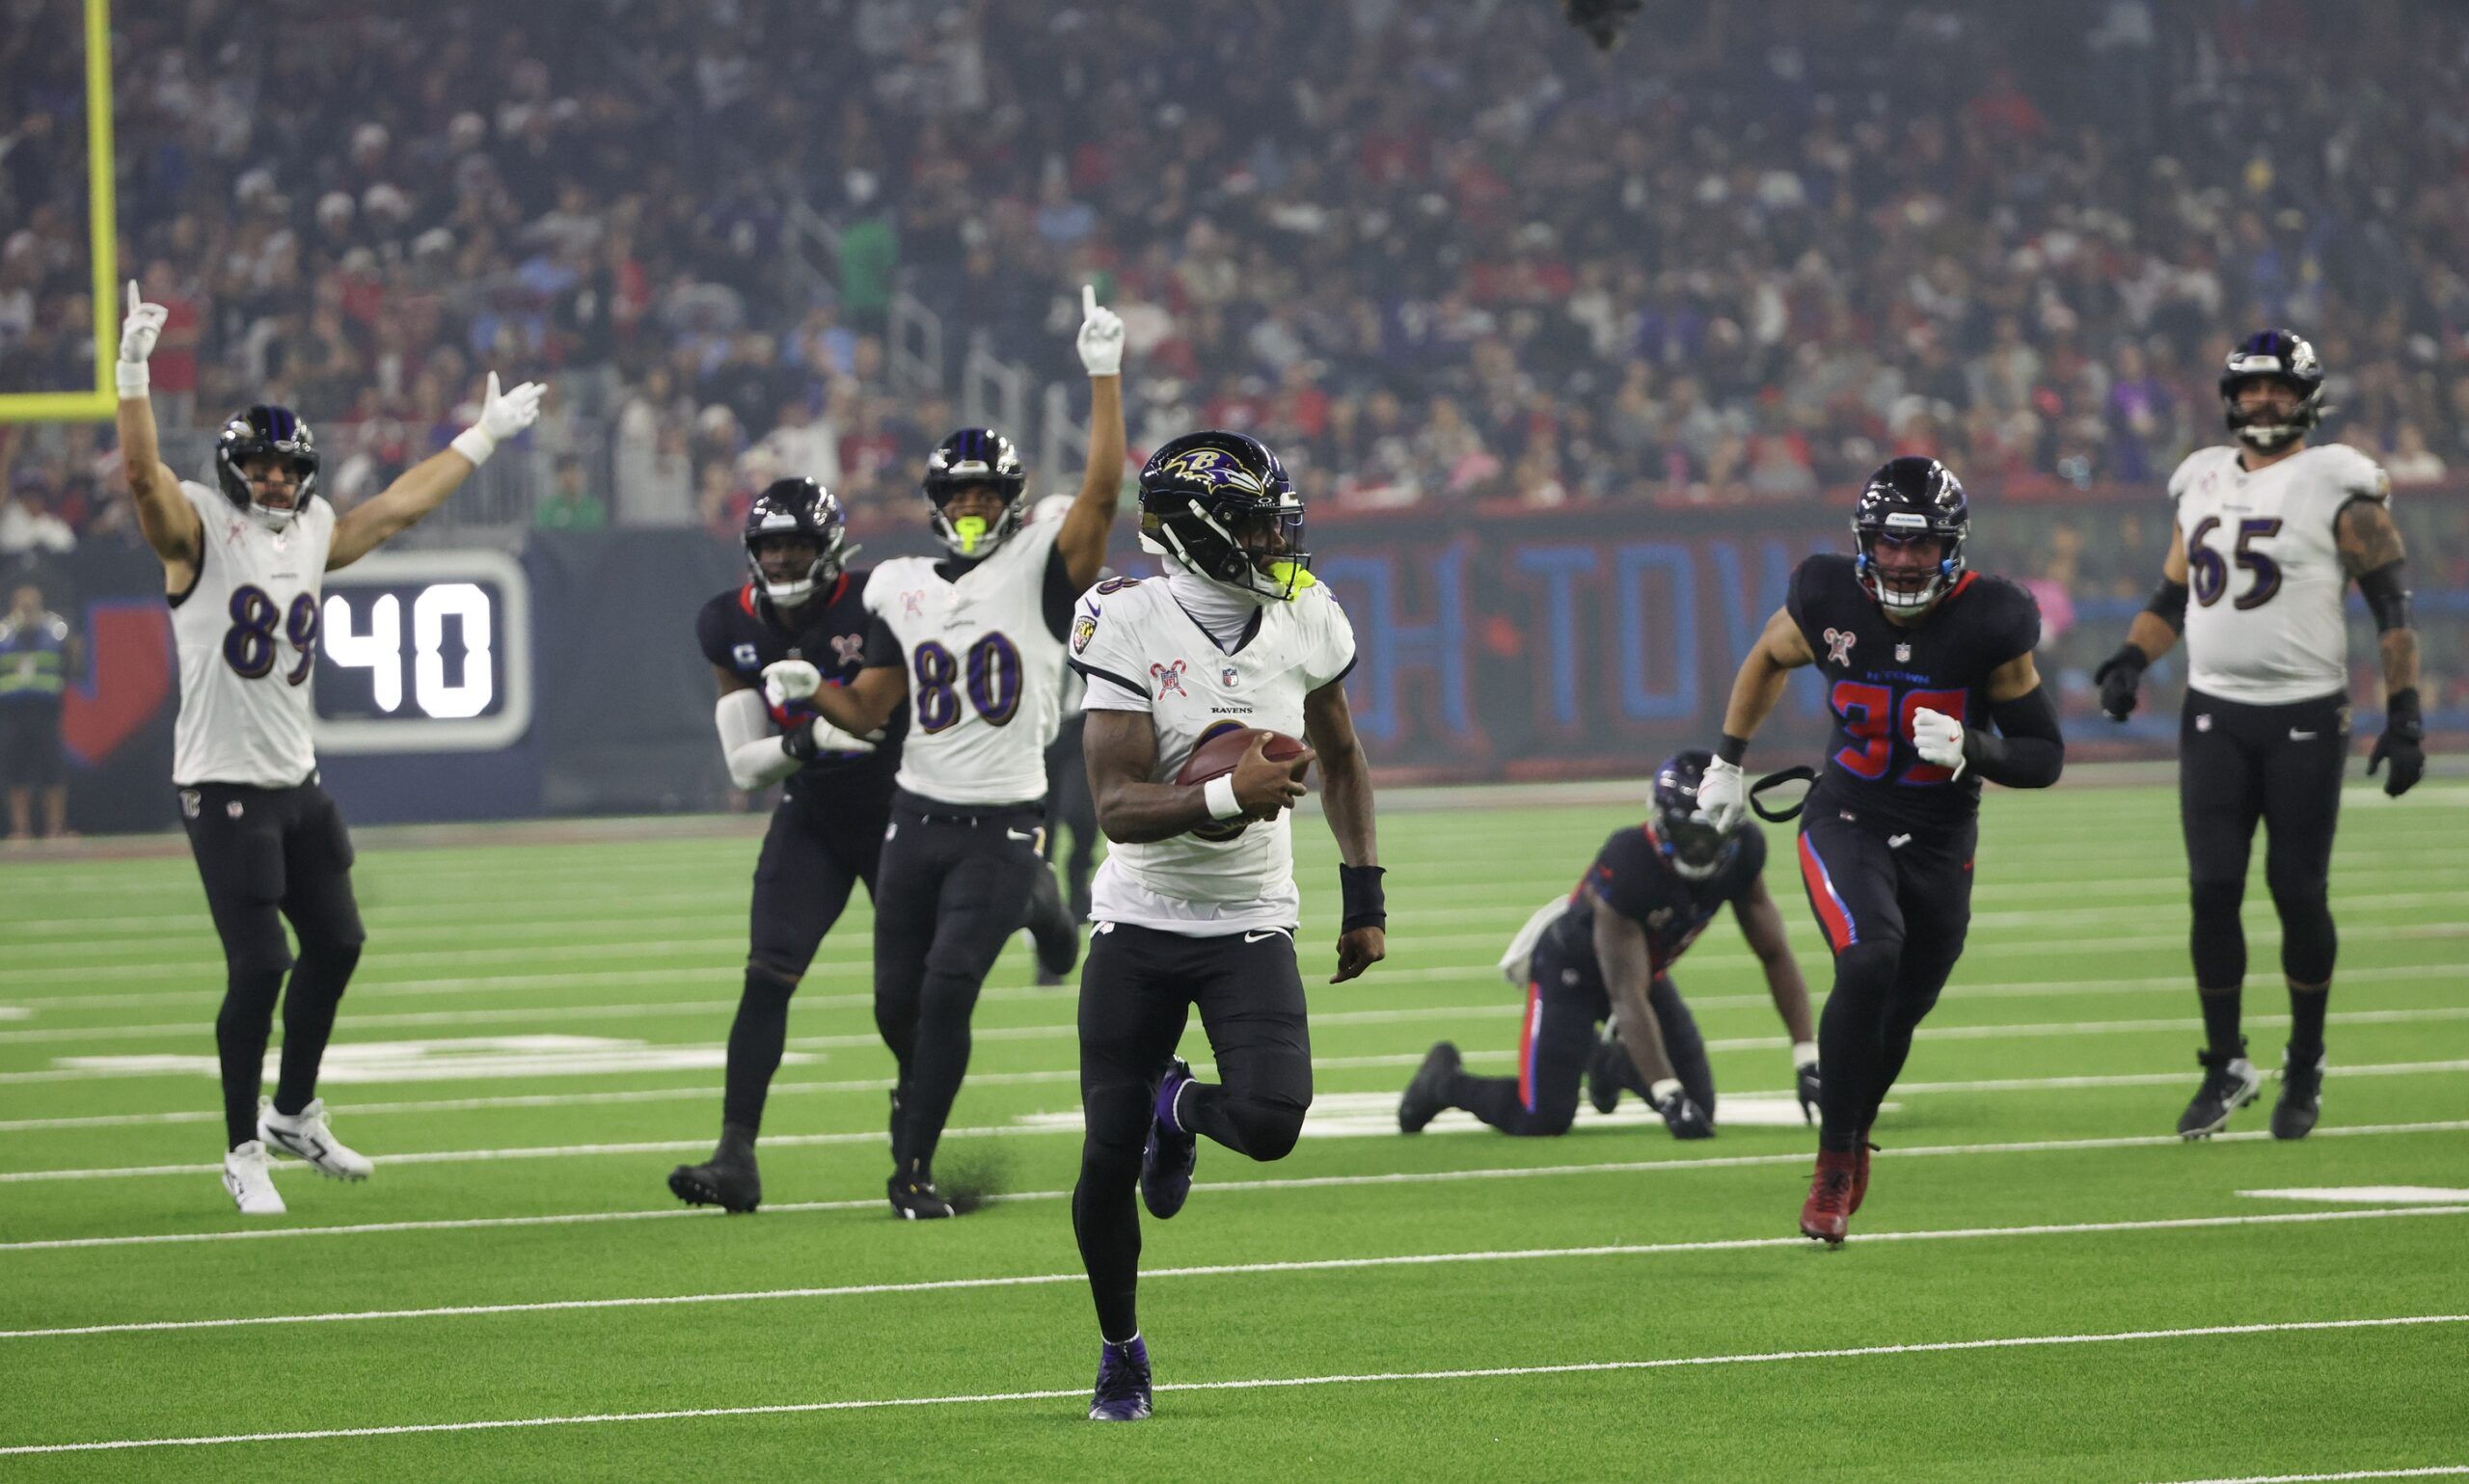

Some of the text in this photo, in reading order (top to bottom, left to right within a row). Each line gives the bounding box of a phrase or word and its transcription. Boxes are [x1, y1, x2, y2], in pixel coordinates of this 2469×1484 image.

[2189, 516, 2282, 609] 65
[223, 583, 319, 687] 89
[324, 583, 492, 718] 40
[914, 630, 1023, 735] 80
